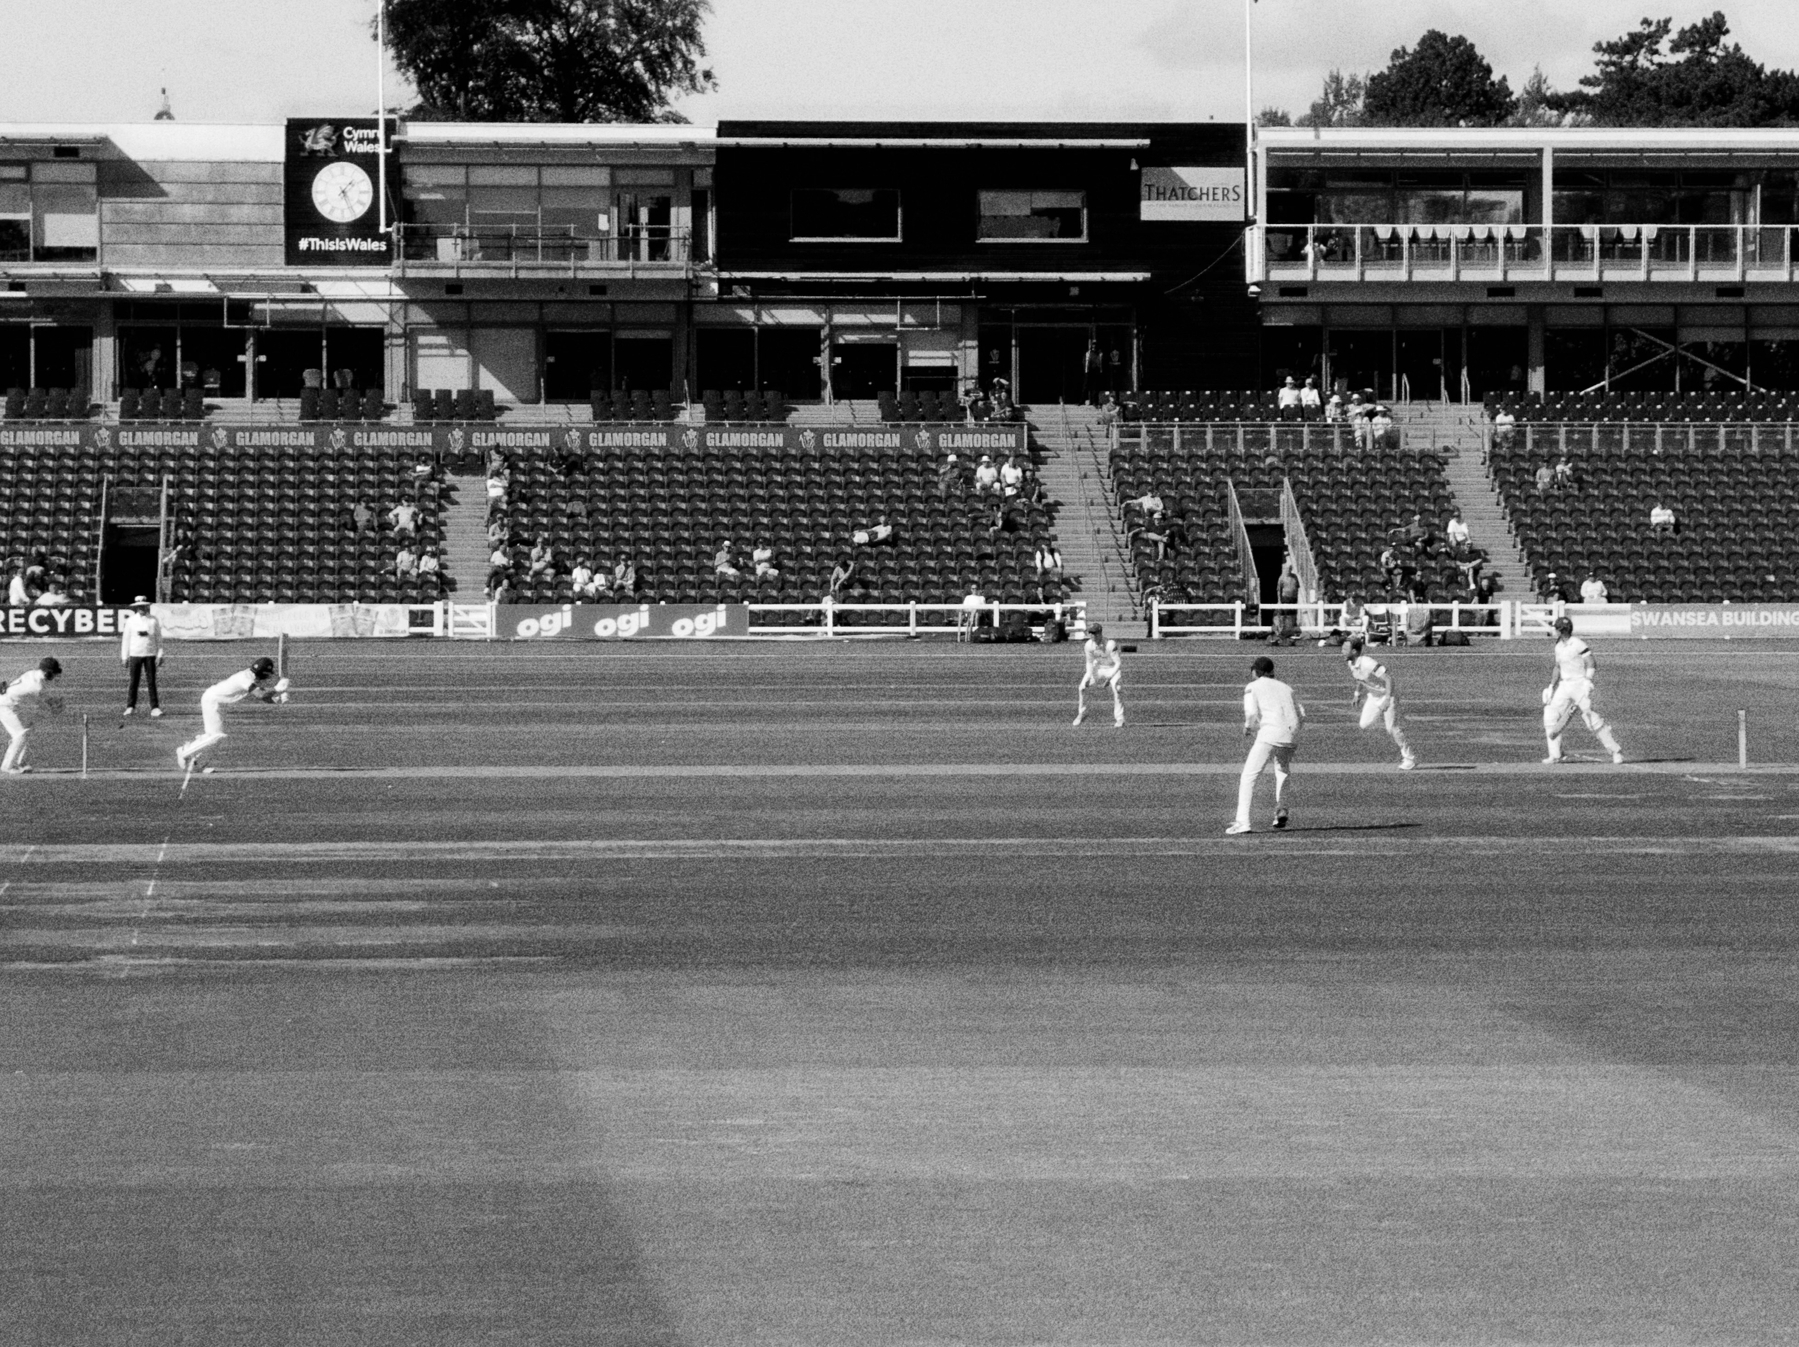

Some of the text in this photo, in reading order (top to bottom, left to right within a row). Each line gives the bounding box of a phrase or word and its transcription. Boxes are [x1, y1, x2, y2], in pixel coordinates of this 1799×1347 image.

[343, 126, 380, 141] Cymr
[343, 140, 381, 153] Wales
[298, 237, 387, 251] #ThisIsWales
[0, 431, 1016, 447] GLAMORGAN GLAMORGAN GLAMORGAN GLAMORGAN GLAMORGAN GLAMORGAN GLAMORGAN GLAMORGAN GLAMORGAN
[0, 608, 137, 633] ECYBER
[516, 603, 727, 637] ogi ogi ogi
[1631, 611, 1799, 626] SWANSEA BUILDING
